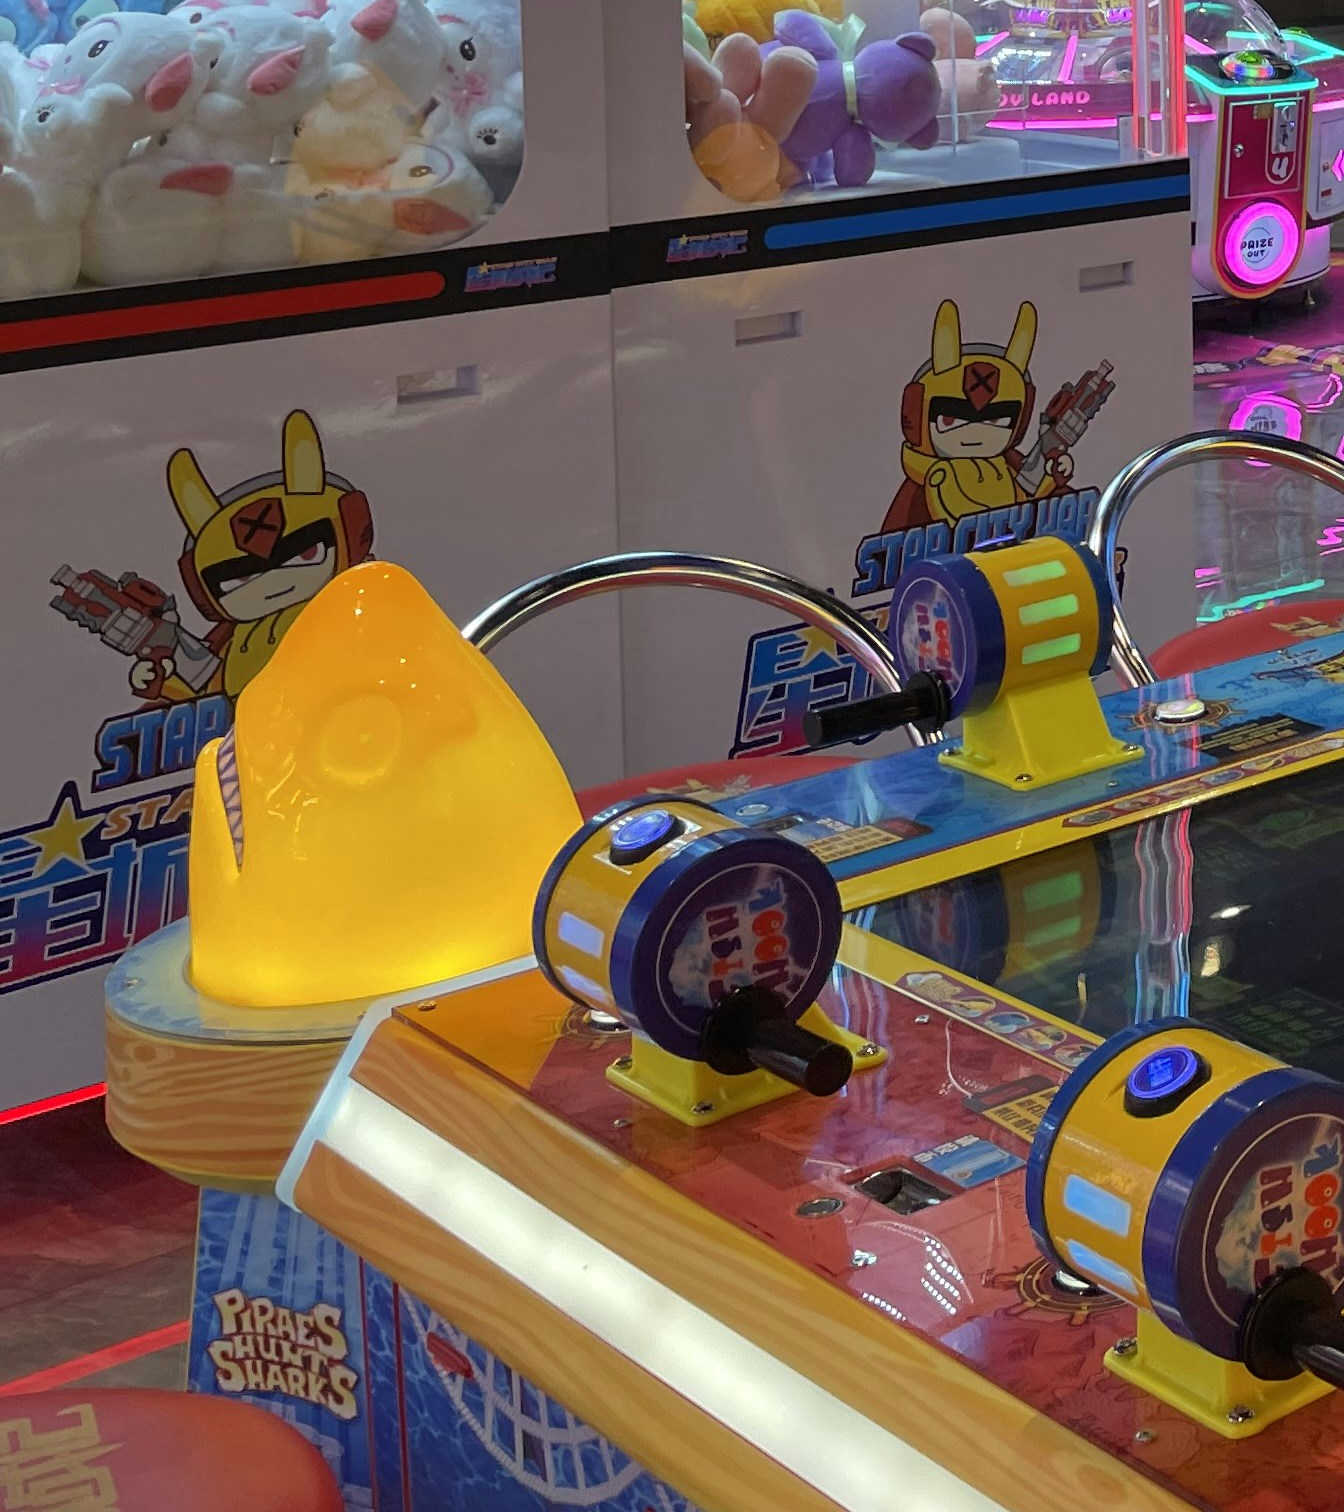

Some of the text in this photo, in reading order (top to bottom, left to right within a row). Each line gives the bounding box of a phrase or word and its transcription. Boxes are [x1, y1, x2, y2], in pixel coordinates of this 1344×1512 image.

[1031, 91, 1091, 106] LAND
[1247, 249, 1266, 258] OUT
[208, 1340, 359, 1420] SHARKS
